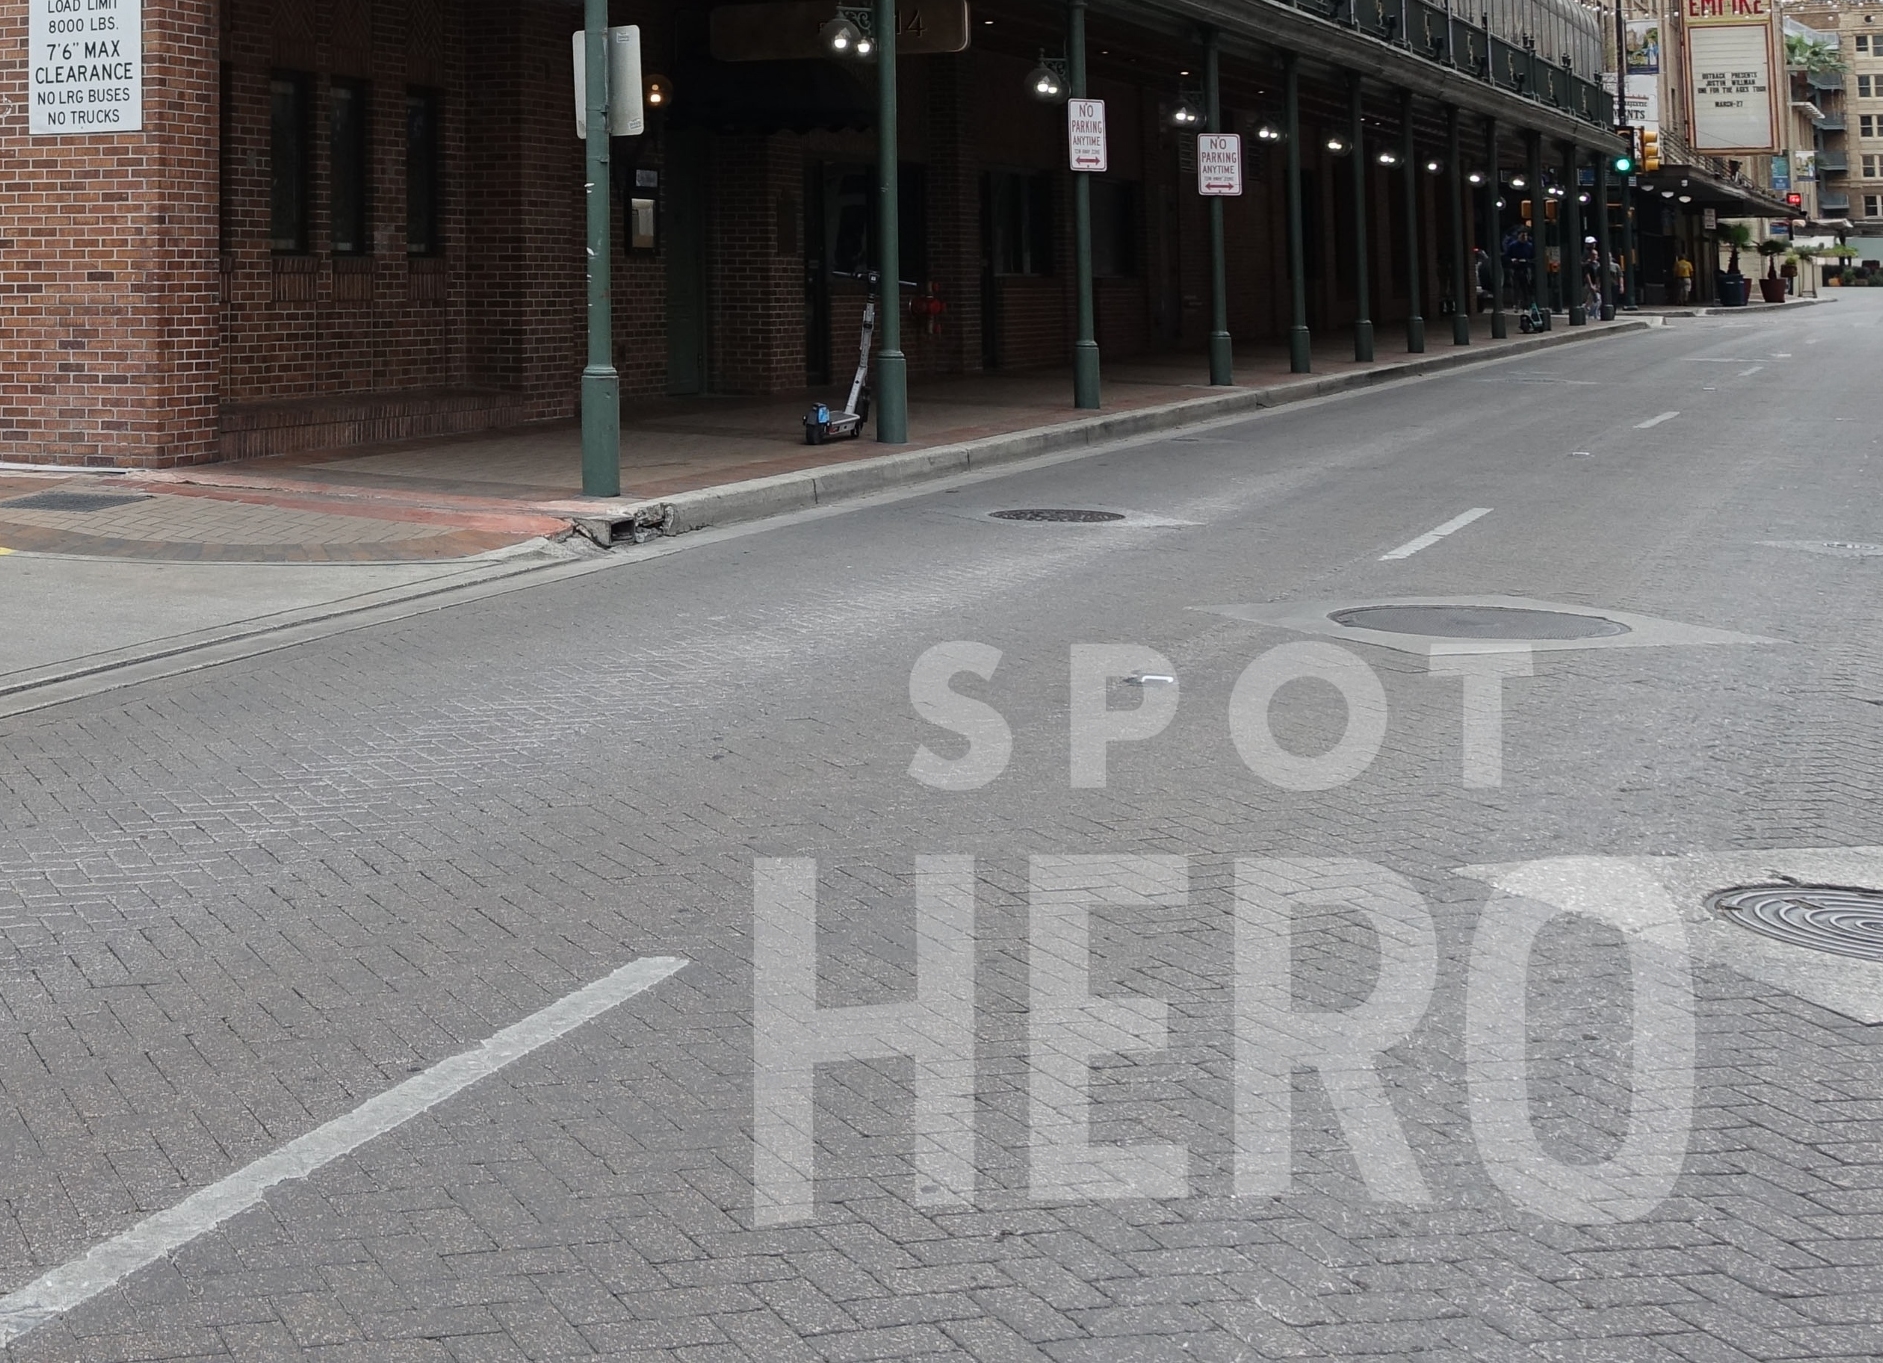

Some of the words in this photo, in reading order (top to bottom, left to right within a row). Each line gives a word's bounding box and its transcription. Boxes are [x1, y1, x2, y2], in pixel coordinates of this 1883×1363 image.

[48, 18, 84, 34] 8000
[90, 16, 119, 31] LBS.
[84, 40, 121, 59] MAX
[35, 62, 133, 84] CLEARANCE
[37, 91, 55, 105] NO
[58, 90, 84, 104] LRG
[88, 87, 130, 103] BUSES
[47, 111, 66, 126] NO
[70, 109, 120, 124] TRUCKS
[1079, 104, 1094, 118] NO
[1071, 120, 1103, 134] PARKING
[1072, 135, 1101, 147] ANYTIME
[1210, 138, 1227, 150] NO
[1201, 151, 1237, 164] PARKING
[1202, 165, 1235, 175] ANYTIME
